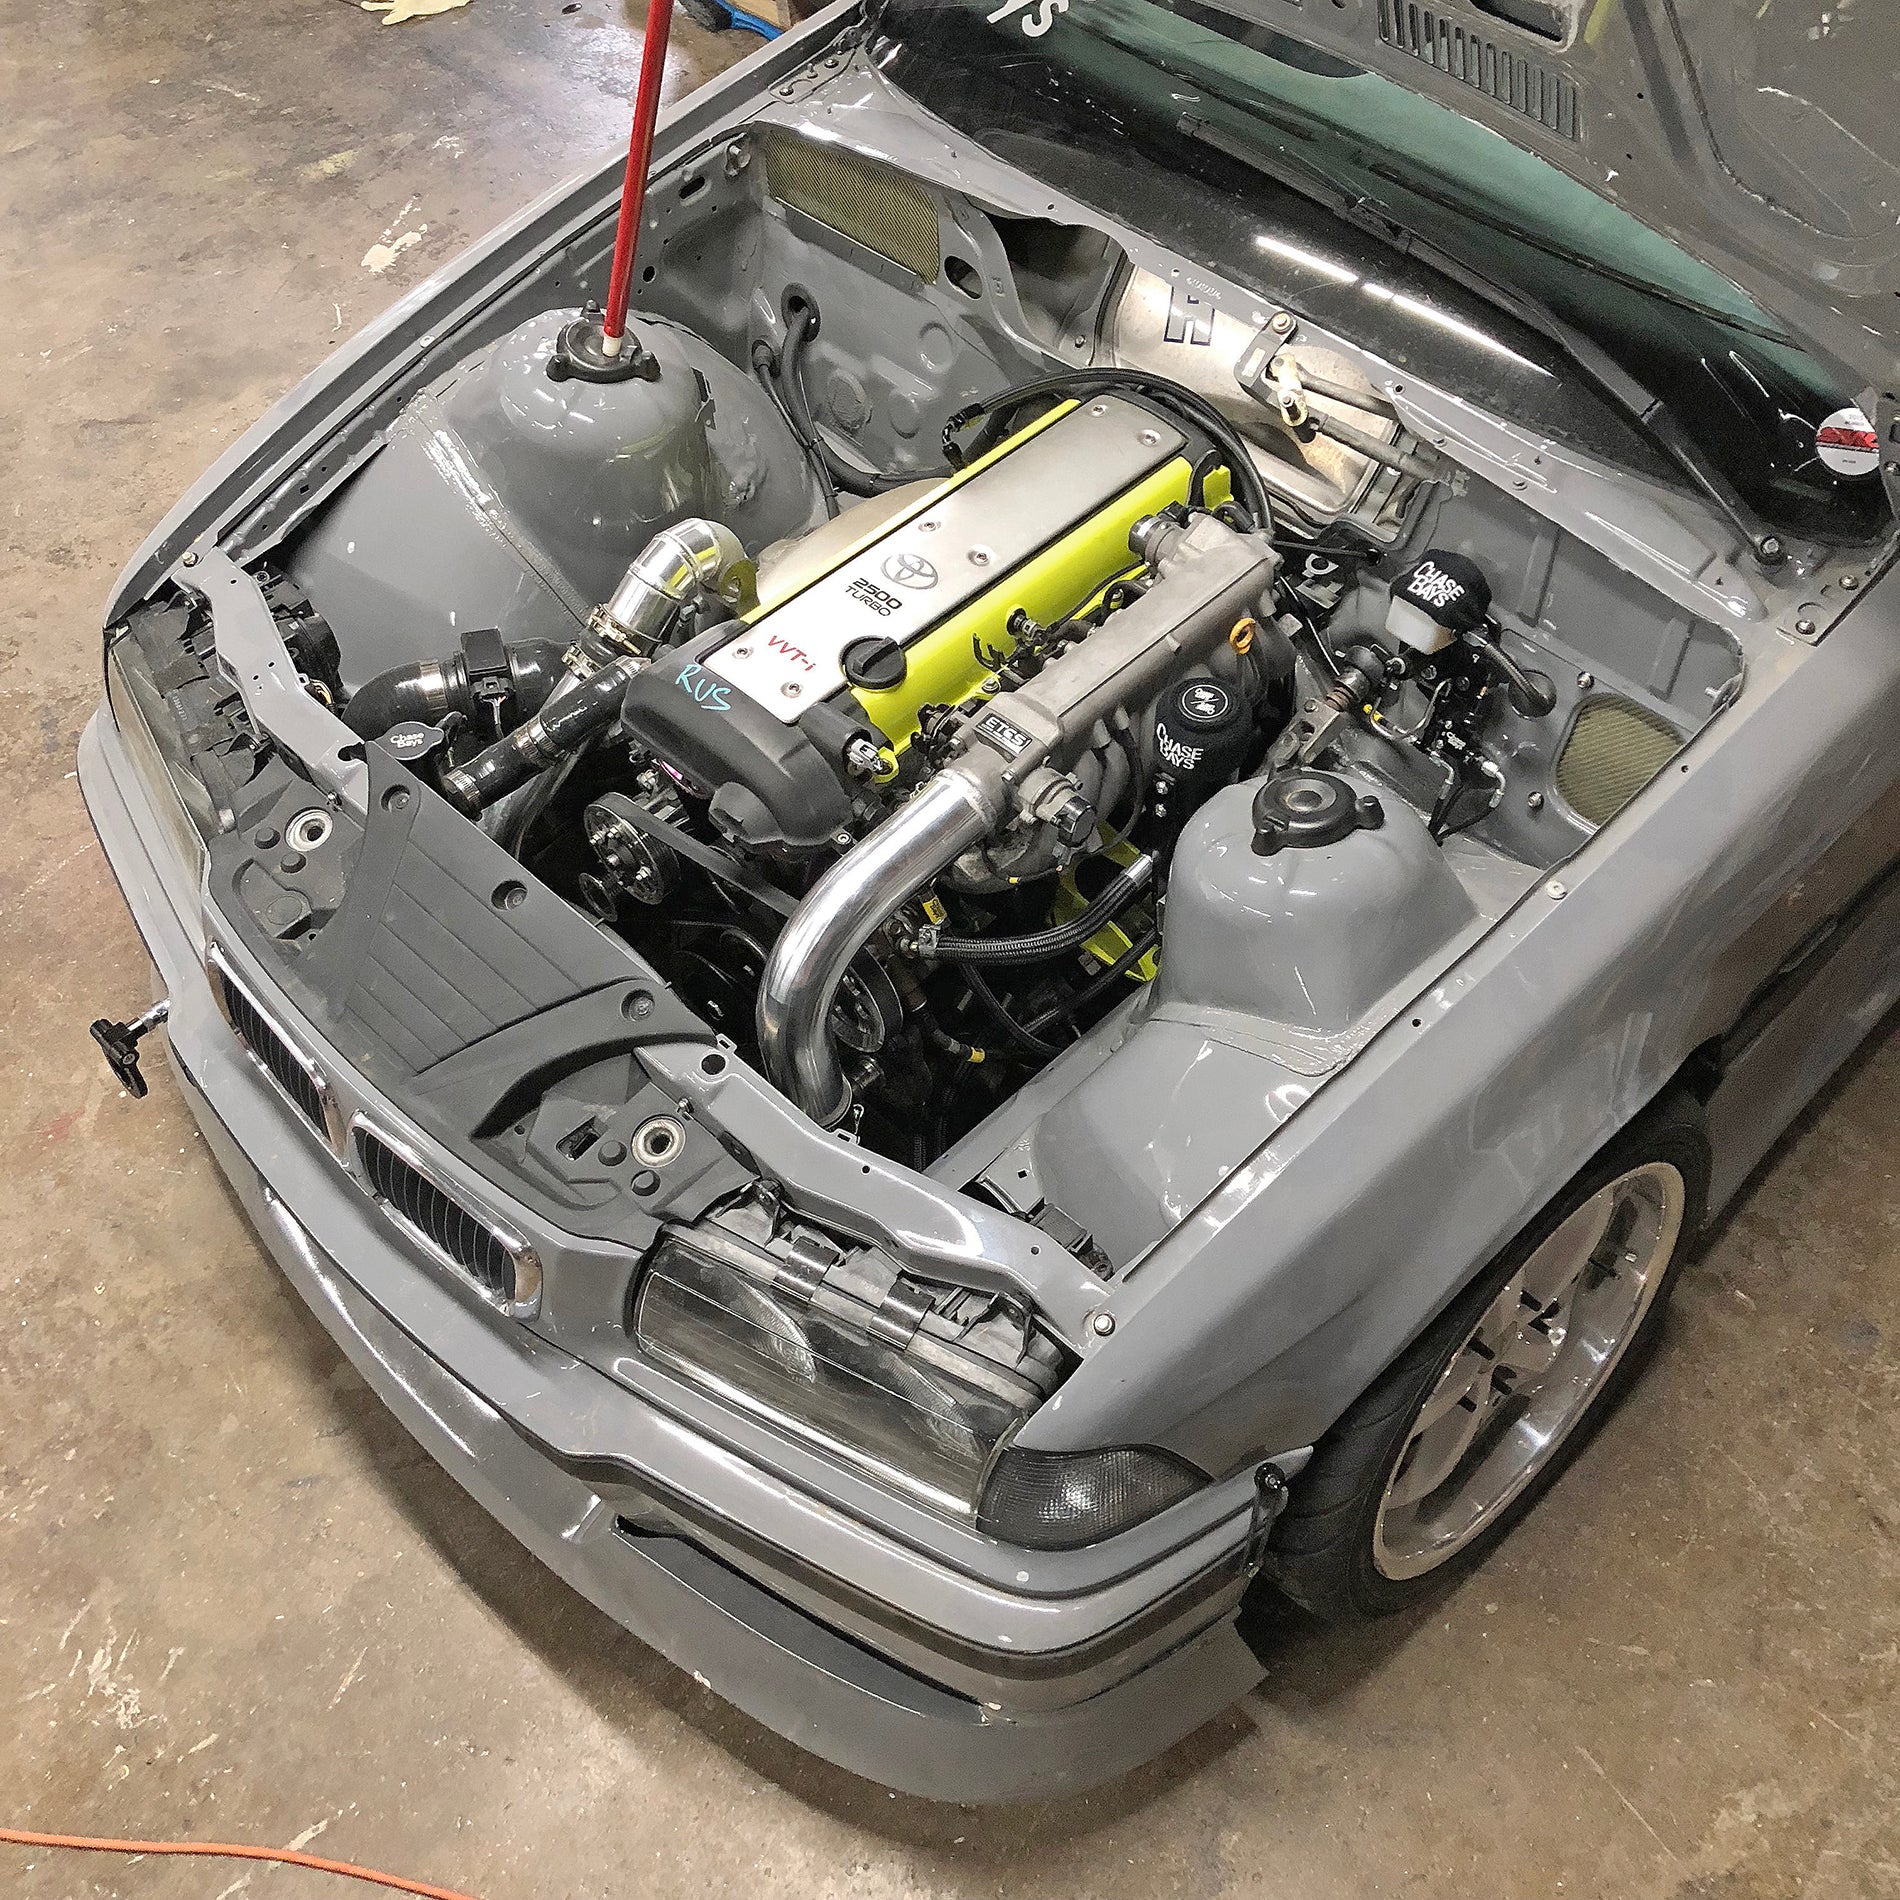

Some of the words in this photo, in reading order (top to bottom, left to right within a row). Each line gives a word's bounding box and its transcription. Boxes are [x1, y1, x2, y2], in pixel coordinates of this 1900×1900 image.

[852, 577, 902, 609] 2500
[1407, 575, 1450, 607] BAYS
[1413, 561, 1465, 601] CHASE
[845, 585, 891, 616] TURBO
[675, 664, 732, 711] RUS
[1156, 723, 1204, 760] CHASE
